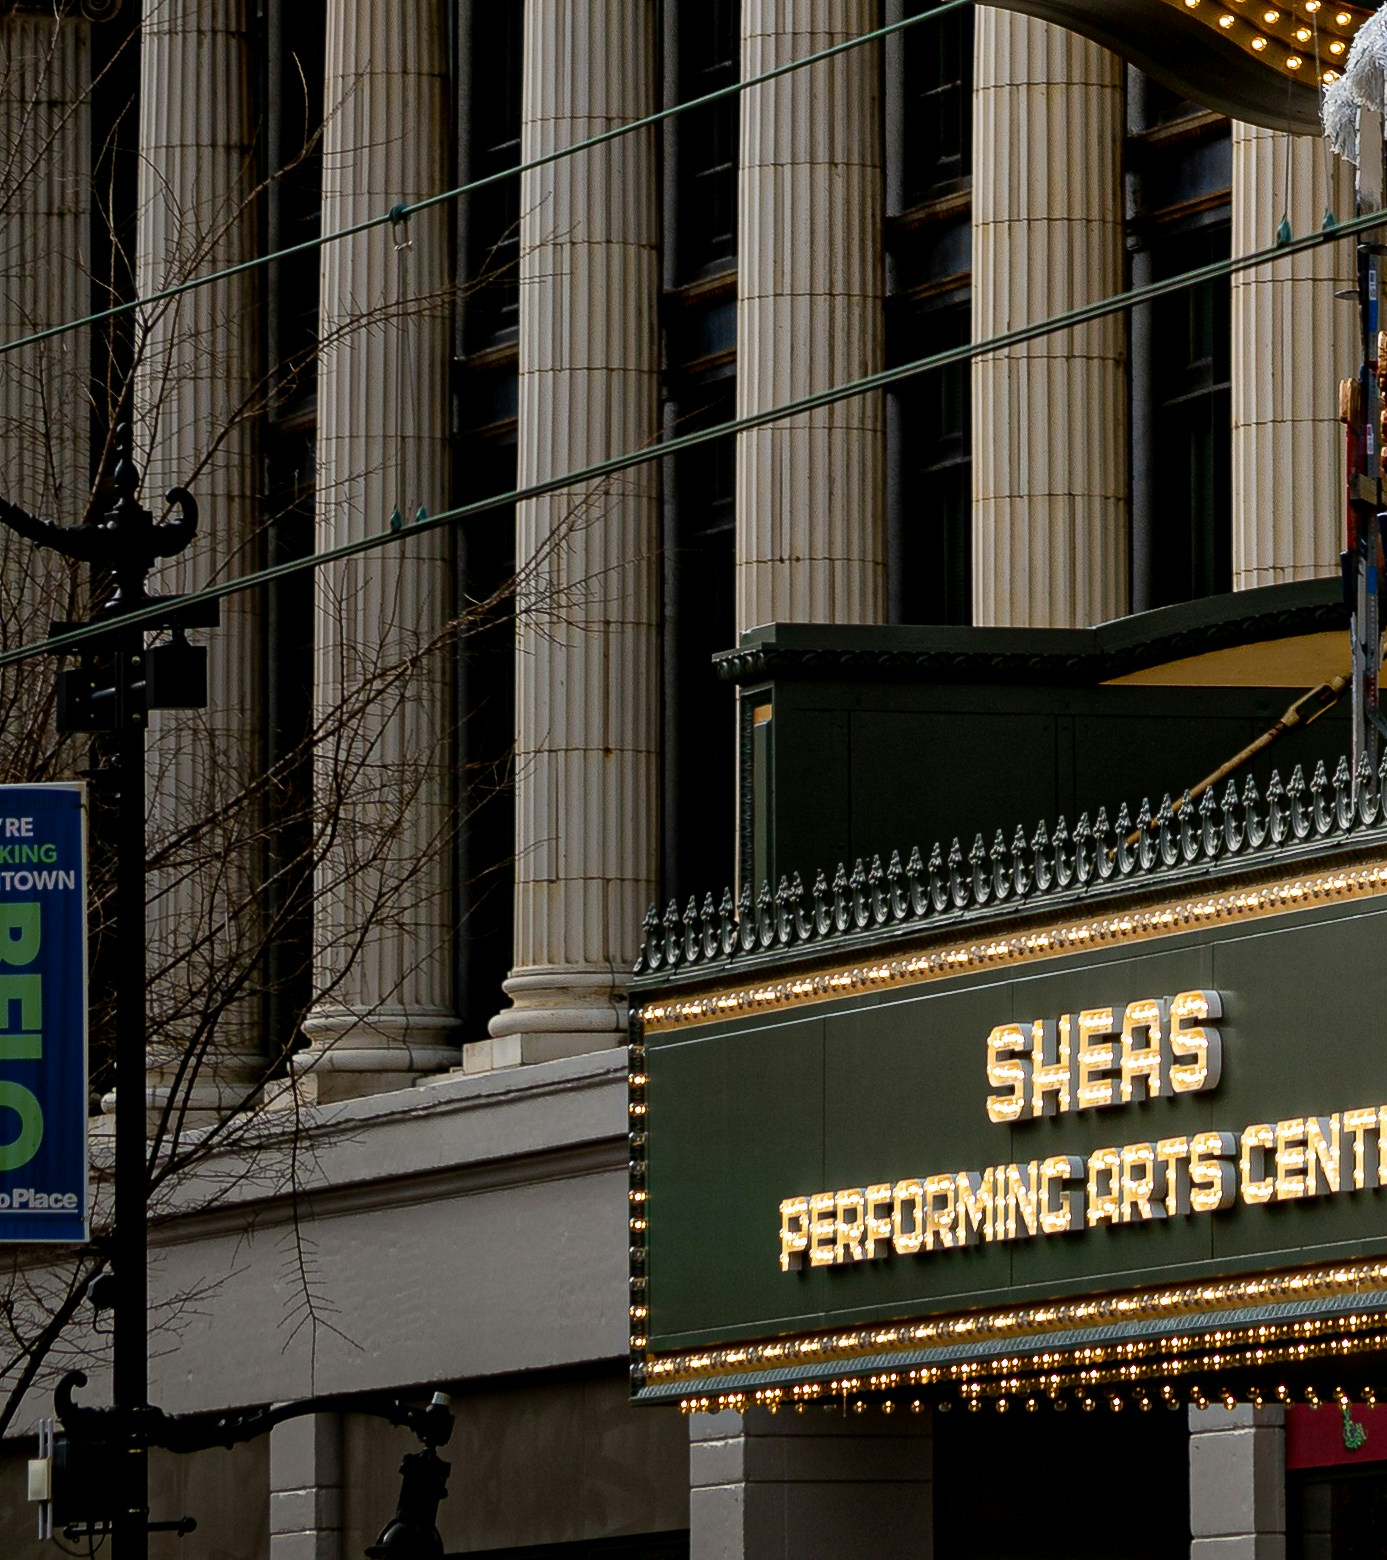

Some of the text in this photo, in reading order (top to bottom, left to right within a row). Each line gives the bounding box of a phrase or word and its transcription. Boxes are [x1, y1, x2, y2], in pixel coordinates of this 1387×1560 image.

[0, 869, 76, 891] TOWN
[12, 1187, 79, 1209] Place
[779, 1156, 1084, 1272] PERFORMING
[1087, 1131, 1235, 1227] ARTS
